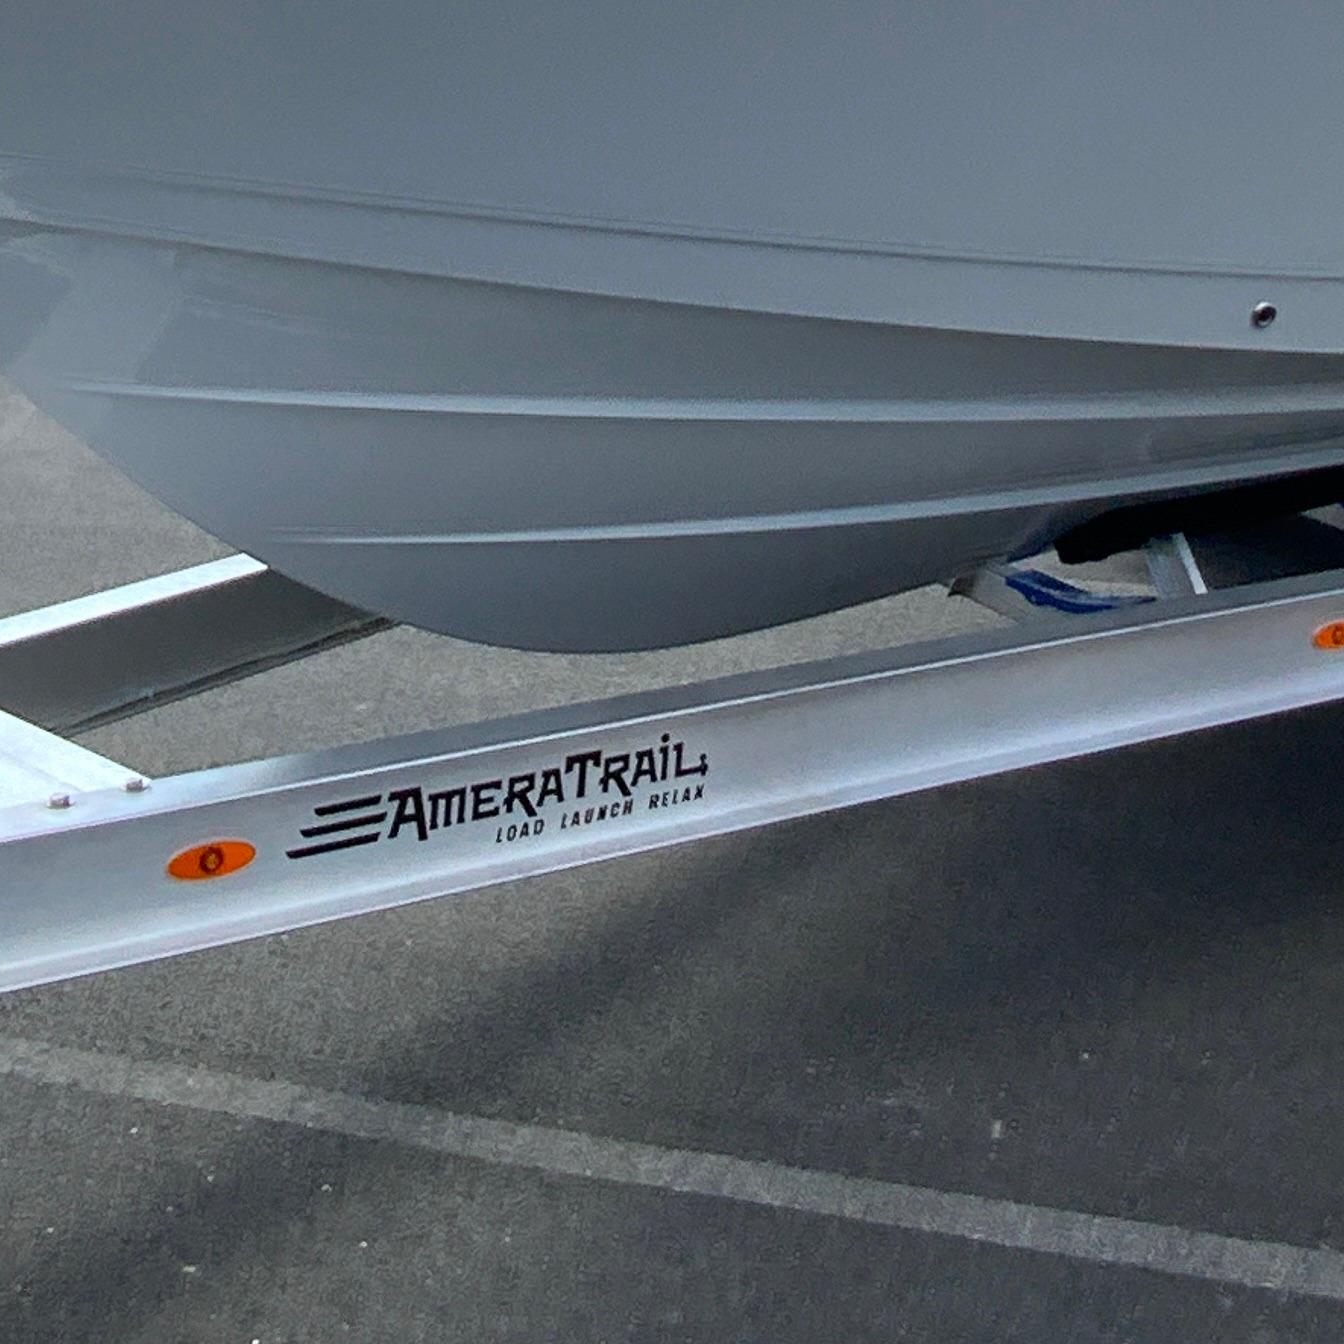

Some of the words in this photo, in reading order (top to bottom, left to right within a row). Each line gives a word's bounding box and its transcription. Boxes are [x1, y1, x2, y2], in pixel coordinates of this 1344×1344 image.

[495, 819, 545, 843] LOAD
[560, 798, 633, 829] LAUNCH
[648, 782, 705, 810] RELAX
